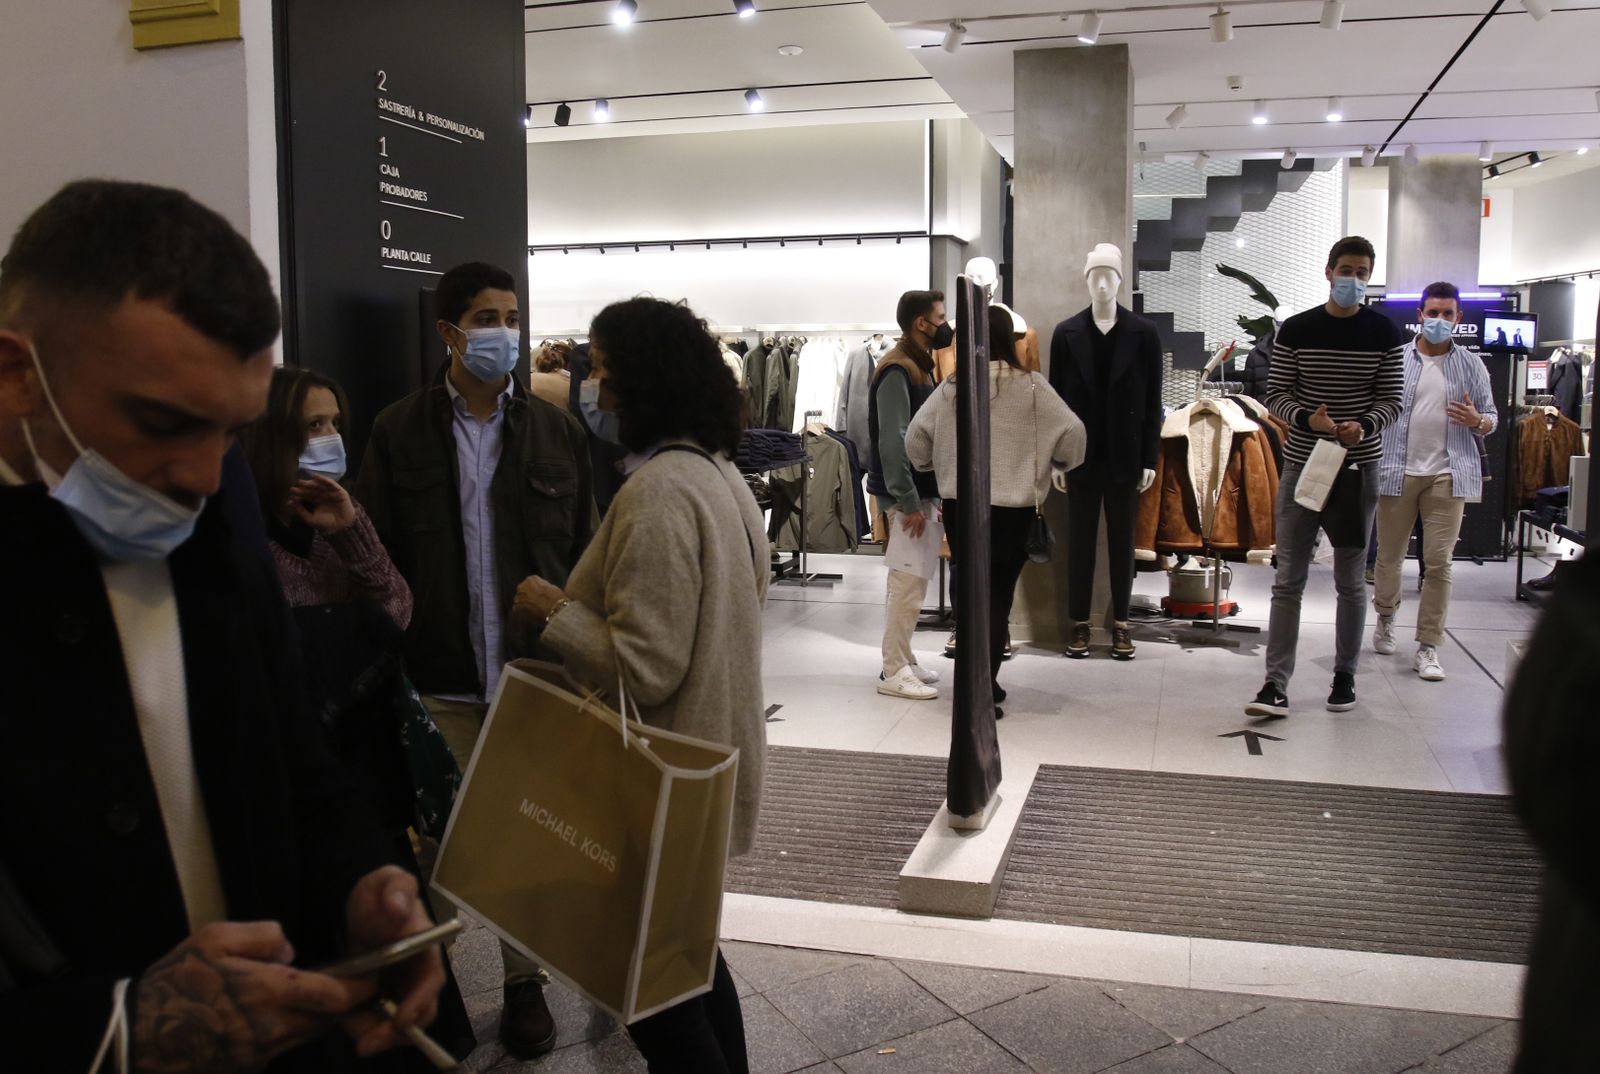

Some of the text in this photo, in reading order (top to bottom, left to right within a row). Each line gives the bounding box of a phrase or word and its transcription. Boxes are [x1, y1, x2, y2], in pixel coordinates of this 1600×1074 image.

[377, 70, 387, 91] 2
[379, 98, 485, 141] SASTRERÍA & PERSONALIZACIÓN
[379, 136, 388, 157] 1
[380, 164, 400, 178] CAJA
[380, 182, 428, 202] PROBADORES
[380, 220, 391, 240] 0
[381, 247, 432, 264] PLANTA CALLE
[519, 798, 617, 873] MICHAEL KORS
